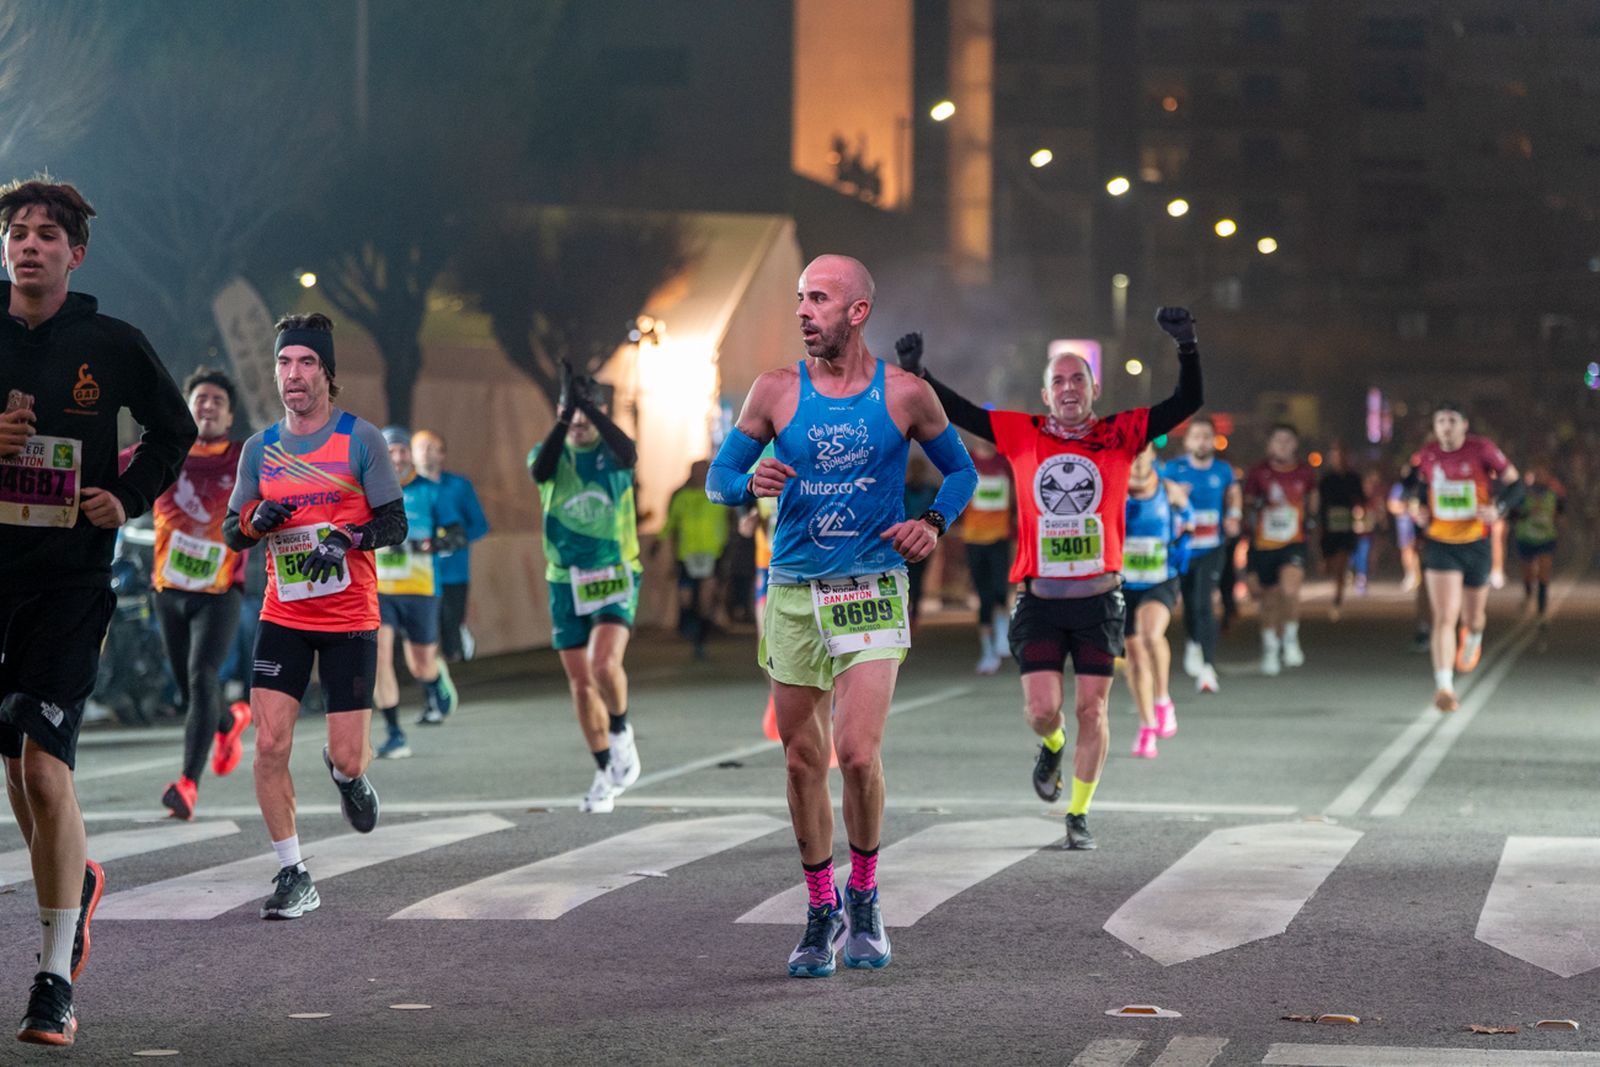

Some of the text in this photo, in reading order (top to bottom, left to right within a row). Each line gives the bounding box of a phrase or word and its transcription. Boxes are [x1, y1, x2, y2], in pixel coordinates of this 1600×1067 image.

[33, 446, 45, 455] DE
[816, 434, 845, 460] 25
[0, 468, 66, 496] 4687
[800, 479, 853, 495] Nutesca
[1051, 537, 1091, 556] 5401
[823, 596, 842, 605] SAN
[831, 598, 893, 627] 8699
